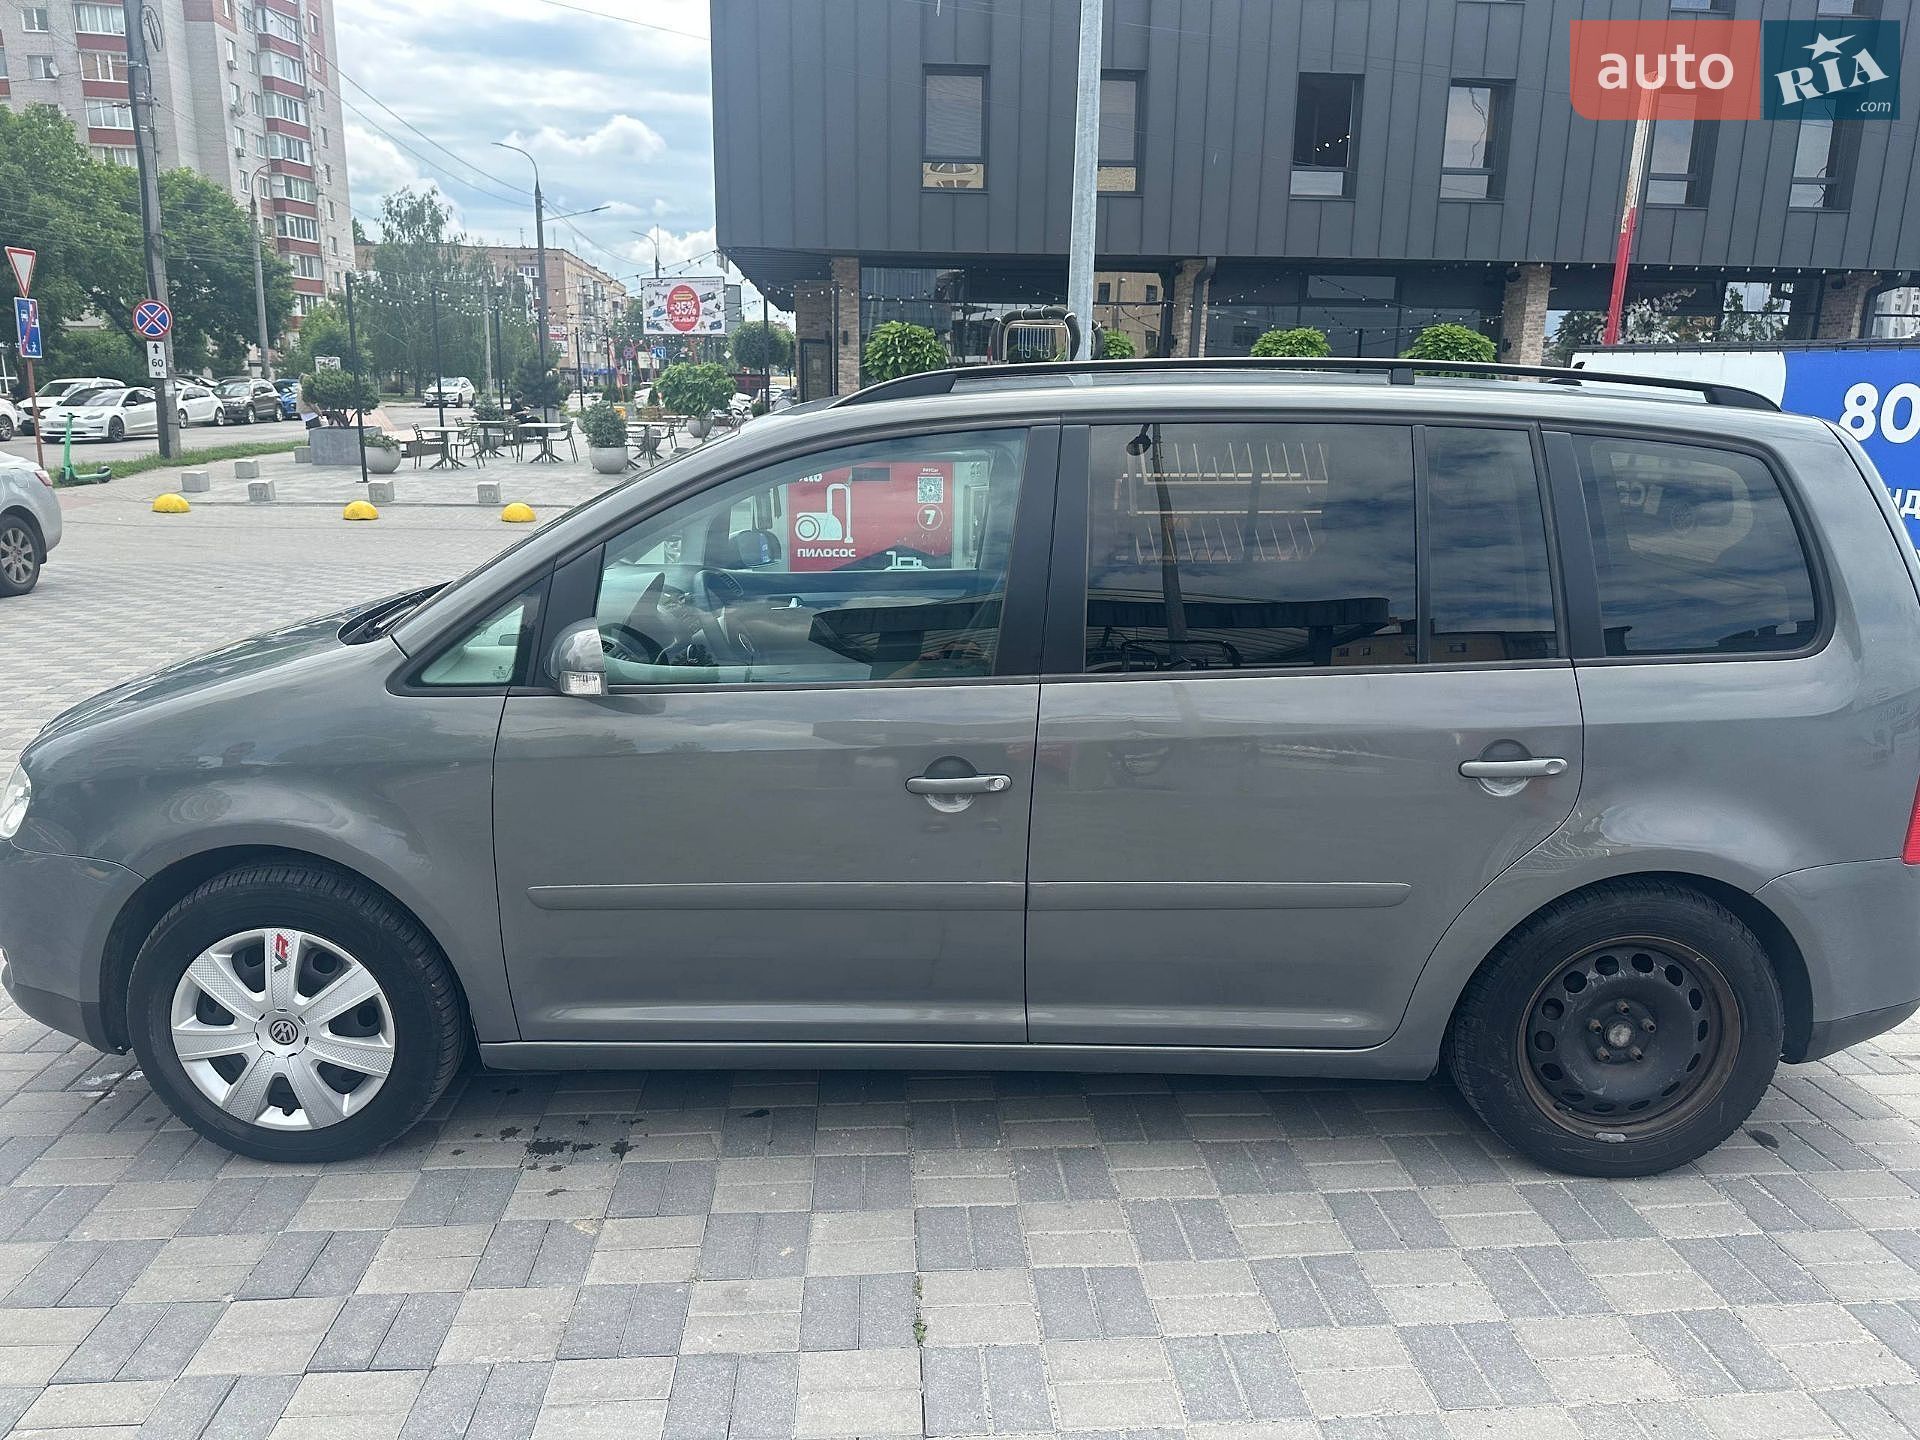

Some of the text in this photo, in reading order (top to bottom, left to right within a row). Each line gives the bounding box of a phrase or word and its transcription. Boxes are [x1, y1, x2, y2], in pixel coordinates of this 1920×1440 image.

[151, 358, 164, 368] 60
[923, 509, 936, 525] 7
[796, 548, 857, 558] ПИЛОСОС
